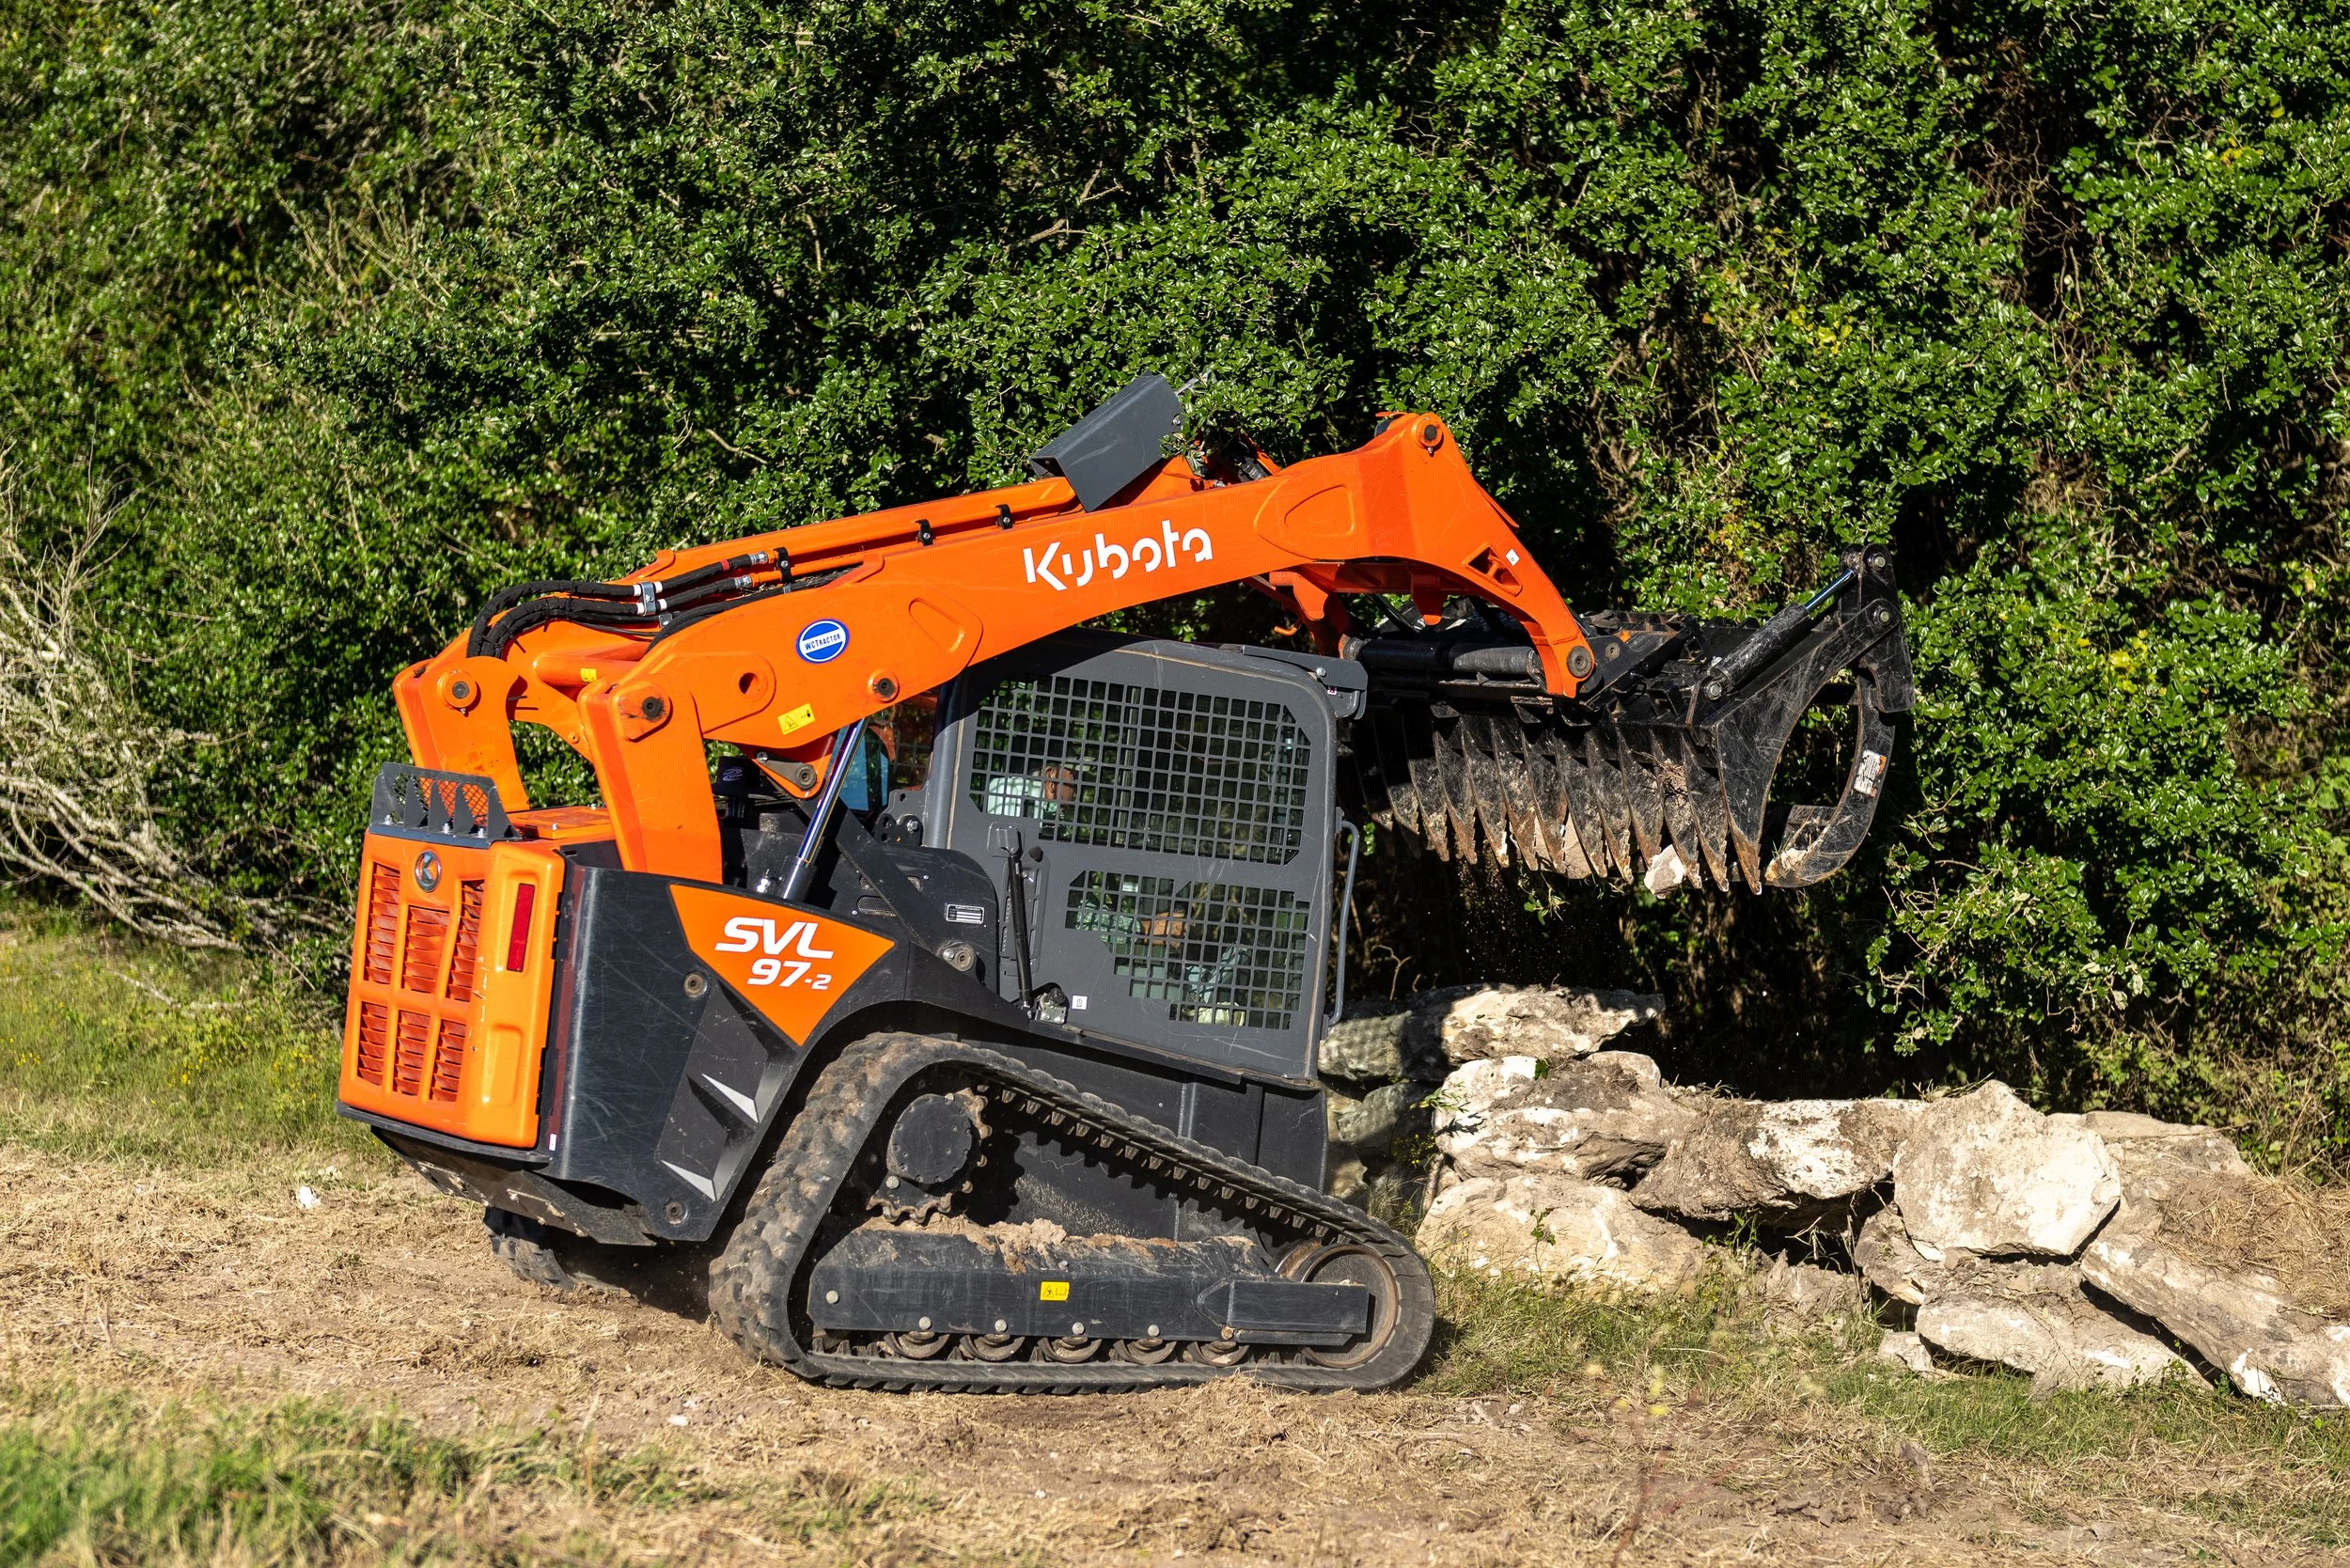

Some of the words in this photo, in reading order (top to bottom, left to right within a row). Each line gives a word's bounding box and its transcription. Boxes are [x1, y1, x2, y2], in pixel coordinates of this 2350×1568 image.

[1023, 520, 1213, 591] Kubota
[714, 917, 834, 959] SVL
[746, 958, 832, 990] 97-2
